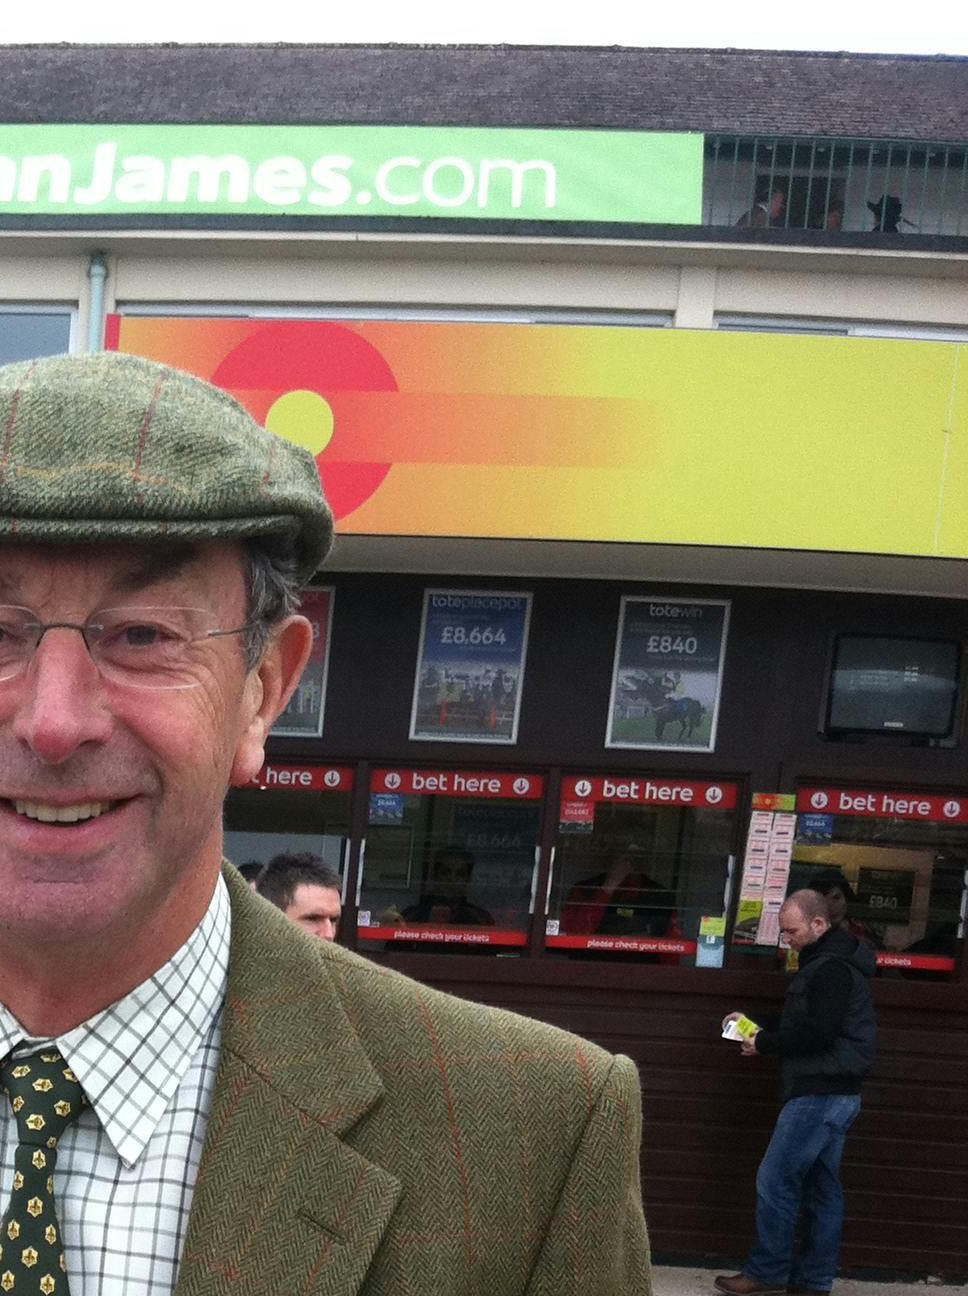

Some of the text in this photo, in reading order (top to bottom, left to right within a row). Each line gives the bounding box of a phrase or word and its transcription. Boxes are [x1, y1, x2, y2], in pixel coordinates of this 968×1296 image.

[649, 604, 703, 617] totewin
[440, 626, 506, 645] £8,664
[646, 635, 697, 654] £840
[266, 767, 312, 785] here
[412, 772, 501, 793] bet here
[602, 780, 693, 801] bet here
[839, 793, 931, 815] bet here
[394, 930, 419, 940] please
[421, 932, 444, 941] check
[587, 939, 685, 952] please check your tickets
